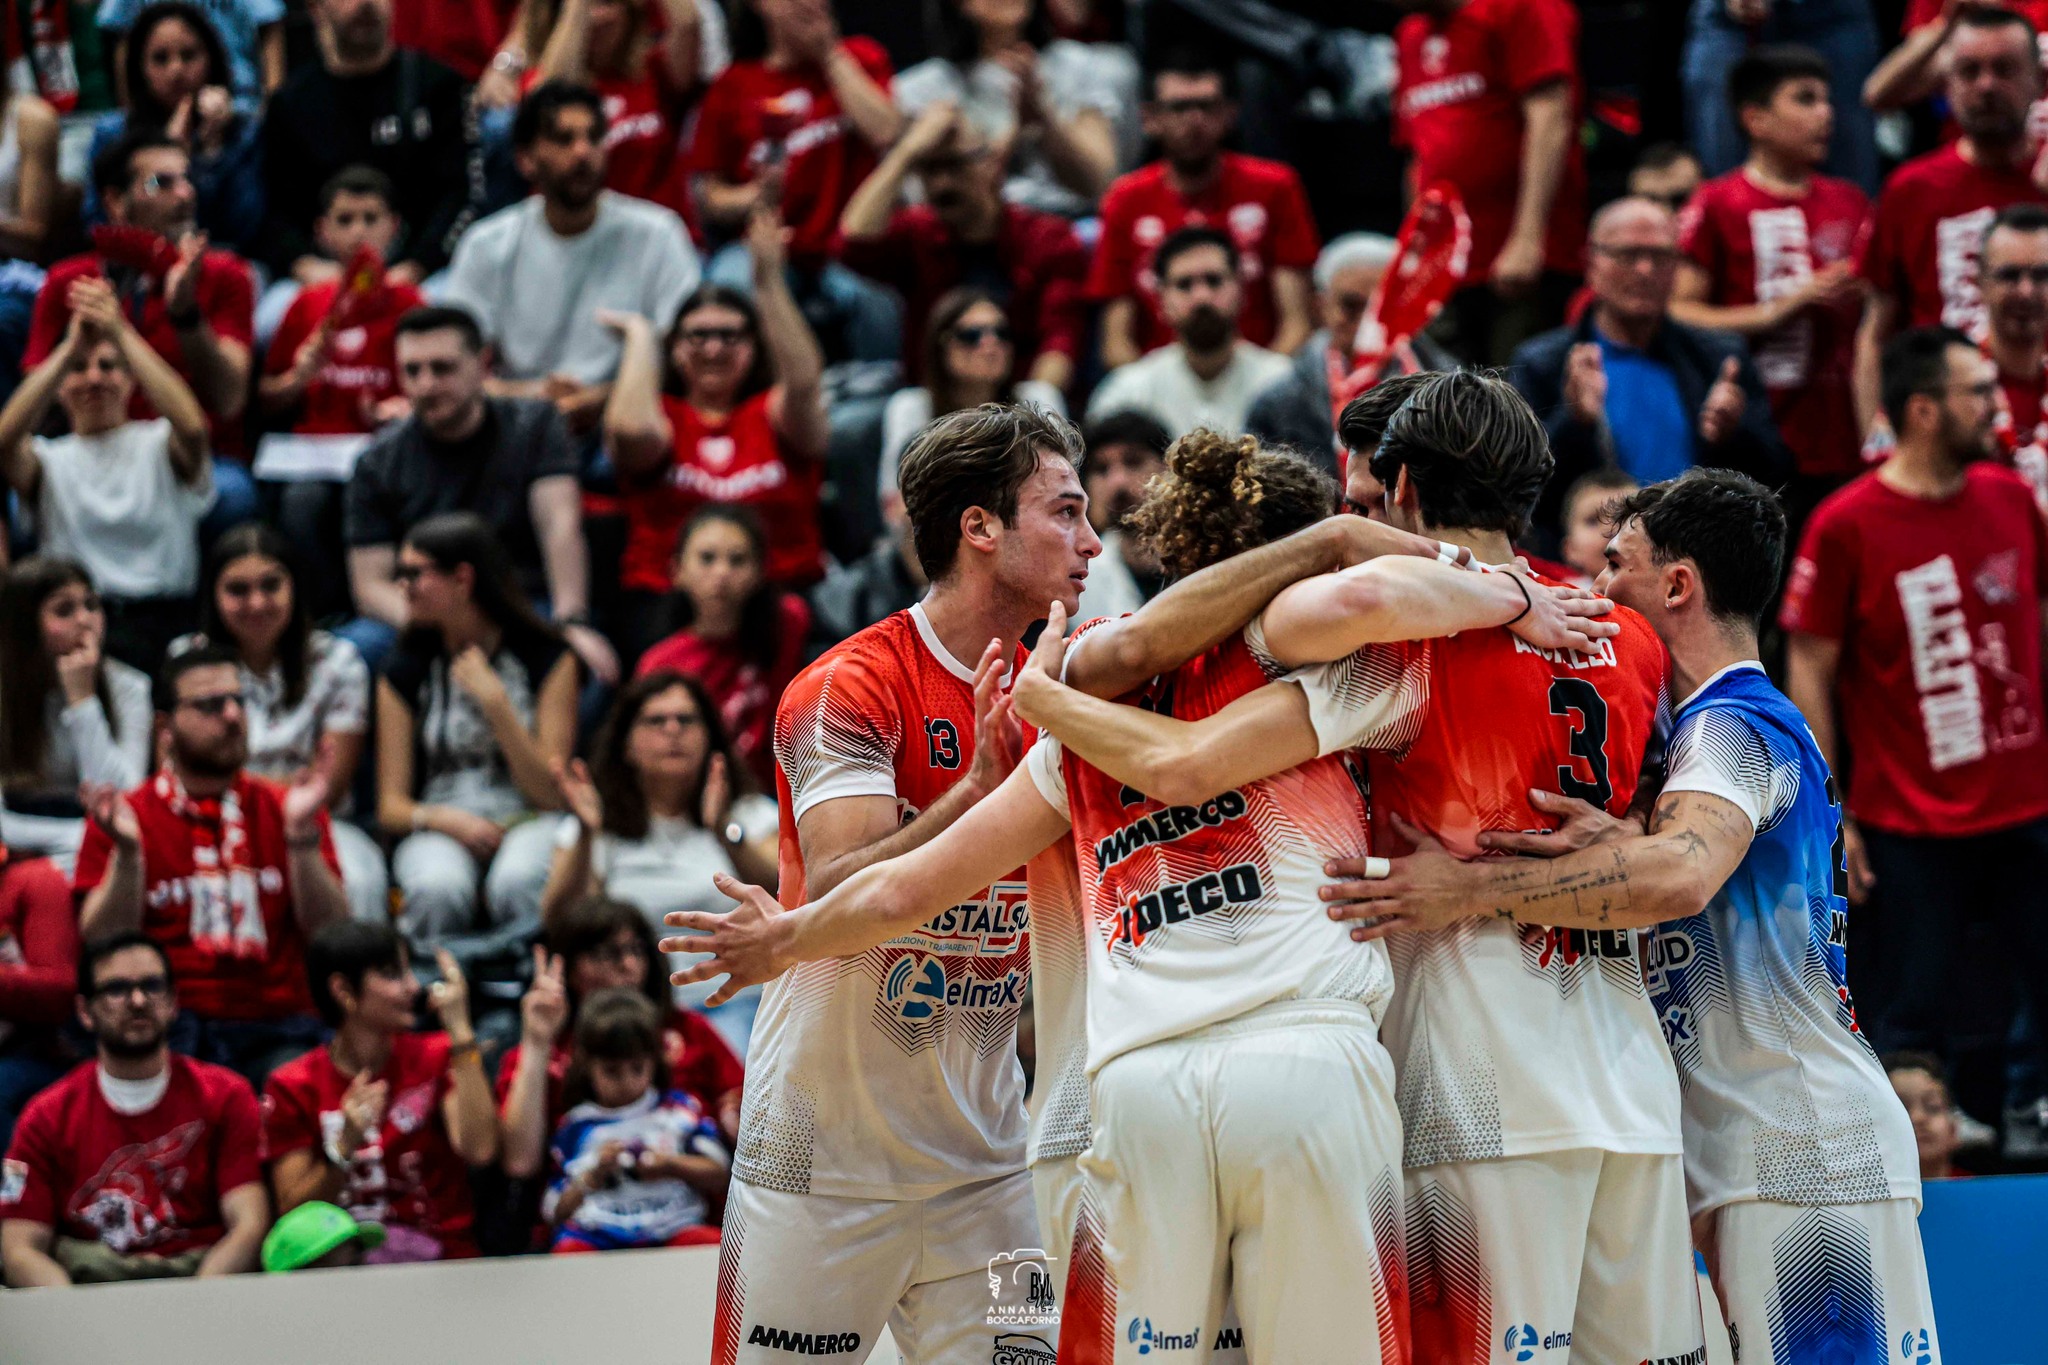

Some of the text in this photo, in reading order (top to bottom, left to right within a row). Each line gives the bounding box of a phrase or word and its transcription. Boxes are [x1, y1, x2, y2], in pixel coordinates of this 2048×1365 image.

[924, 715, 962, 770] 13
[1548, 676, 1613, 812] 3
[747, 1324, 861, 1355] AMMERCO
[1543, 1331, 1572, 1351] elma
